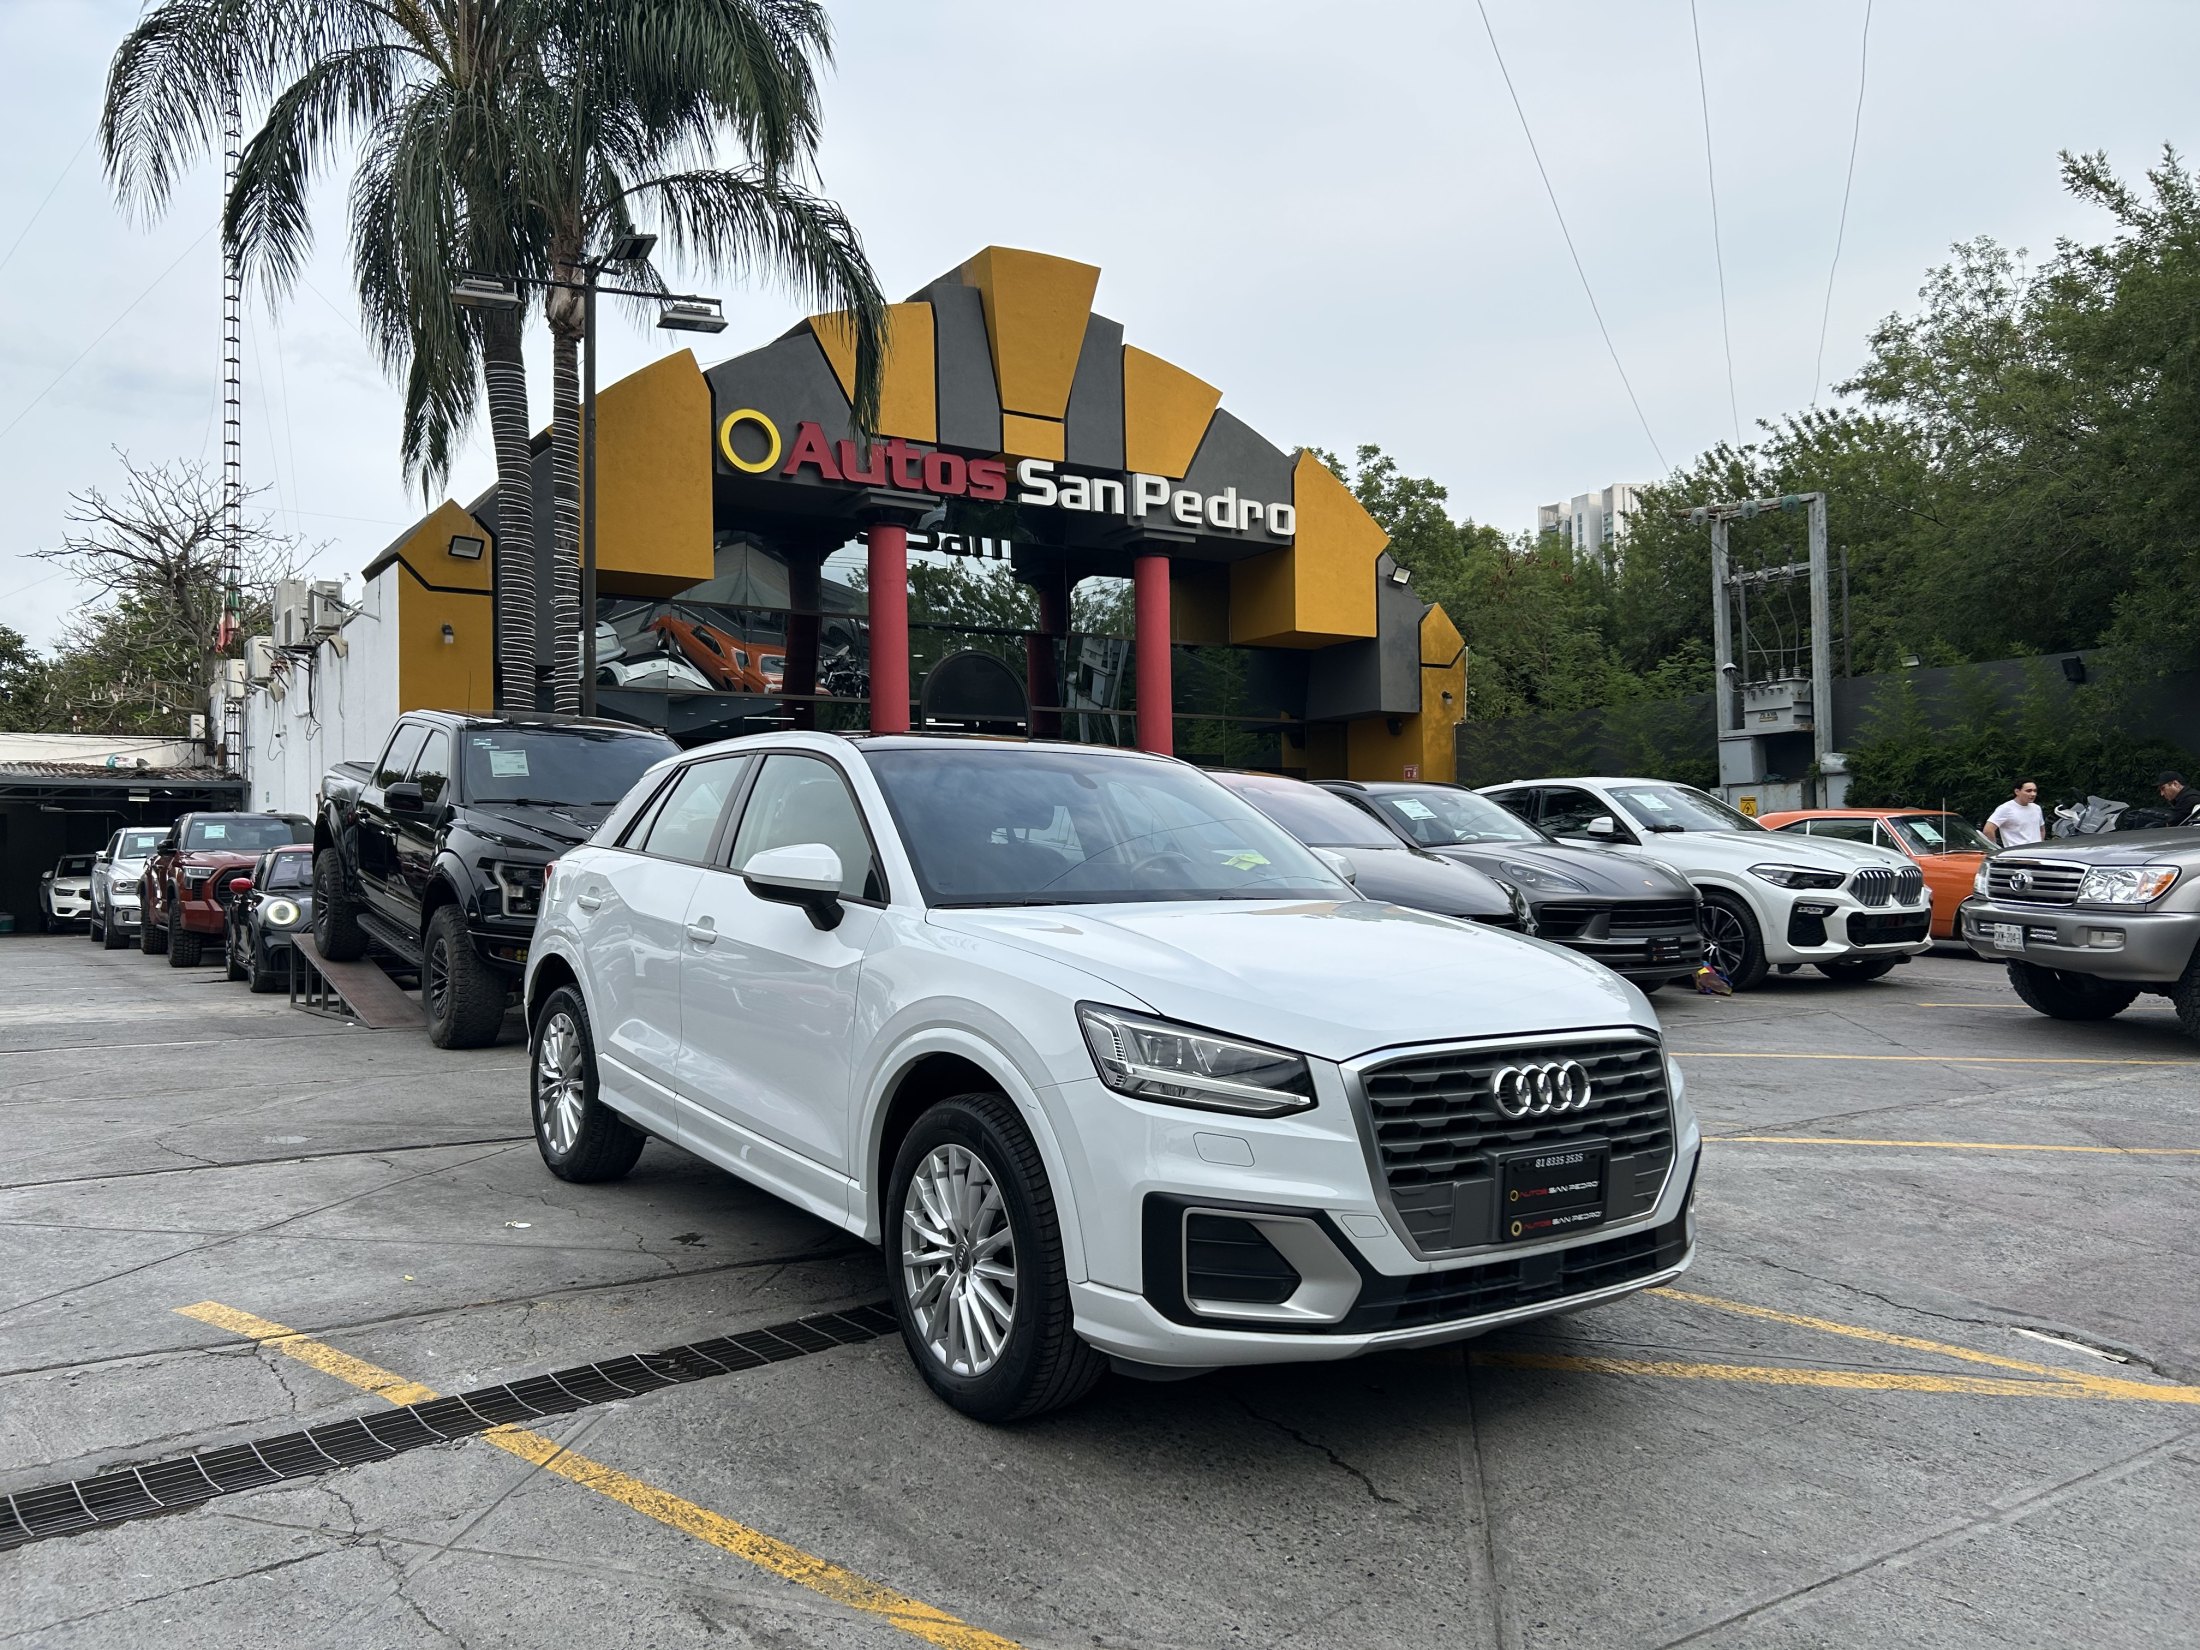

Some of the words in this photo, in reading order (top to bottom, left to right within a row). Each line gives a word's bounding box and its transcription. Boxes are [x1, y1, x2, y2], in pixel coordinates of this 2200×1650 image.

[780, 420, 1007, 501] Autos
[1016, 458, 1125, 515] San
[1132, 472, 1296, 537] Pedro
[1535, 1158, 1546, 1168] 81
[1546, 1155, 1565, 1167] 8335
[1565, 1153, 1583, 1164] 3535
[1548, 1185, 1568, 1194] SAN
[1568, 1181, 1599, 1190] PEDRO
[1552, 1216, 1572, 1225] SAN
[1571, 1211, 1602, 1221] PEDRO
